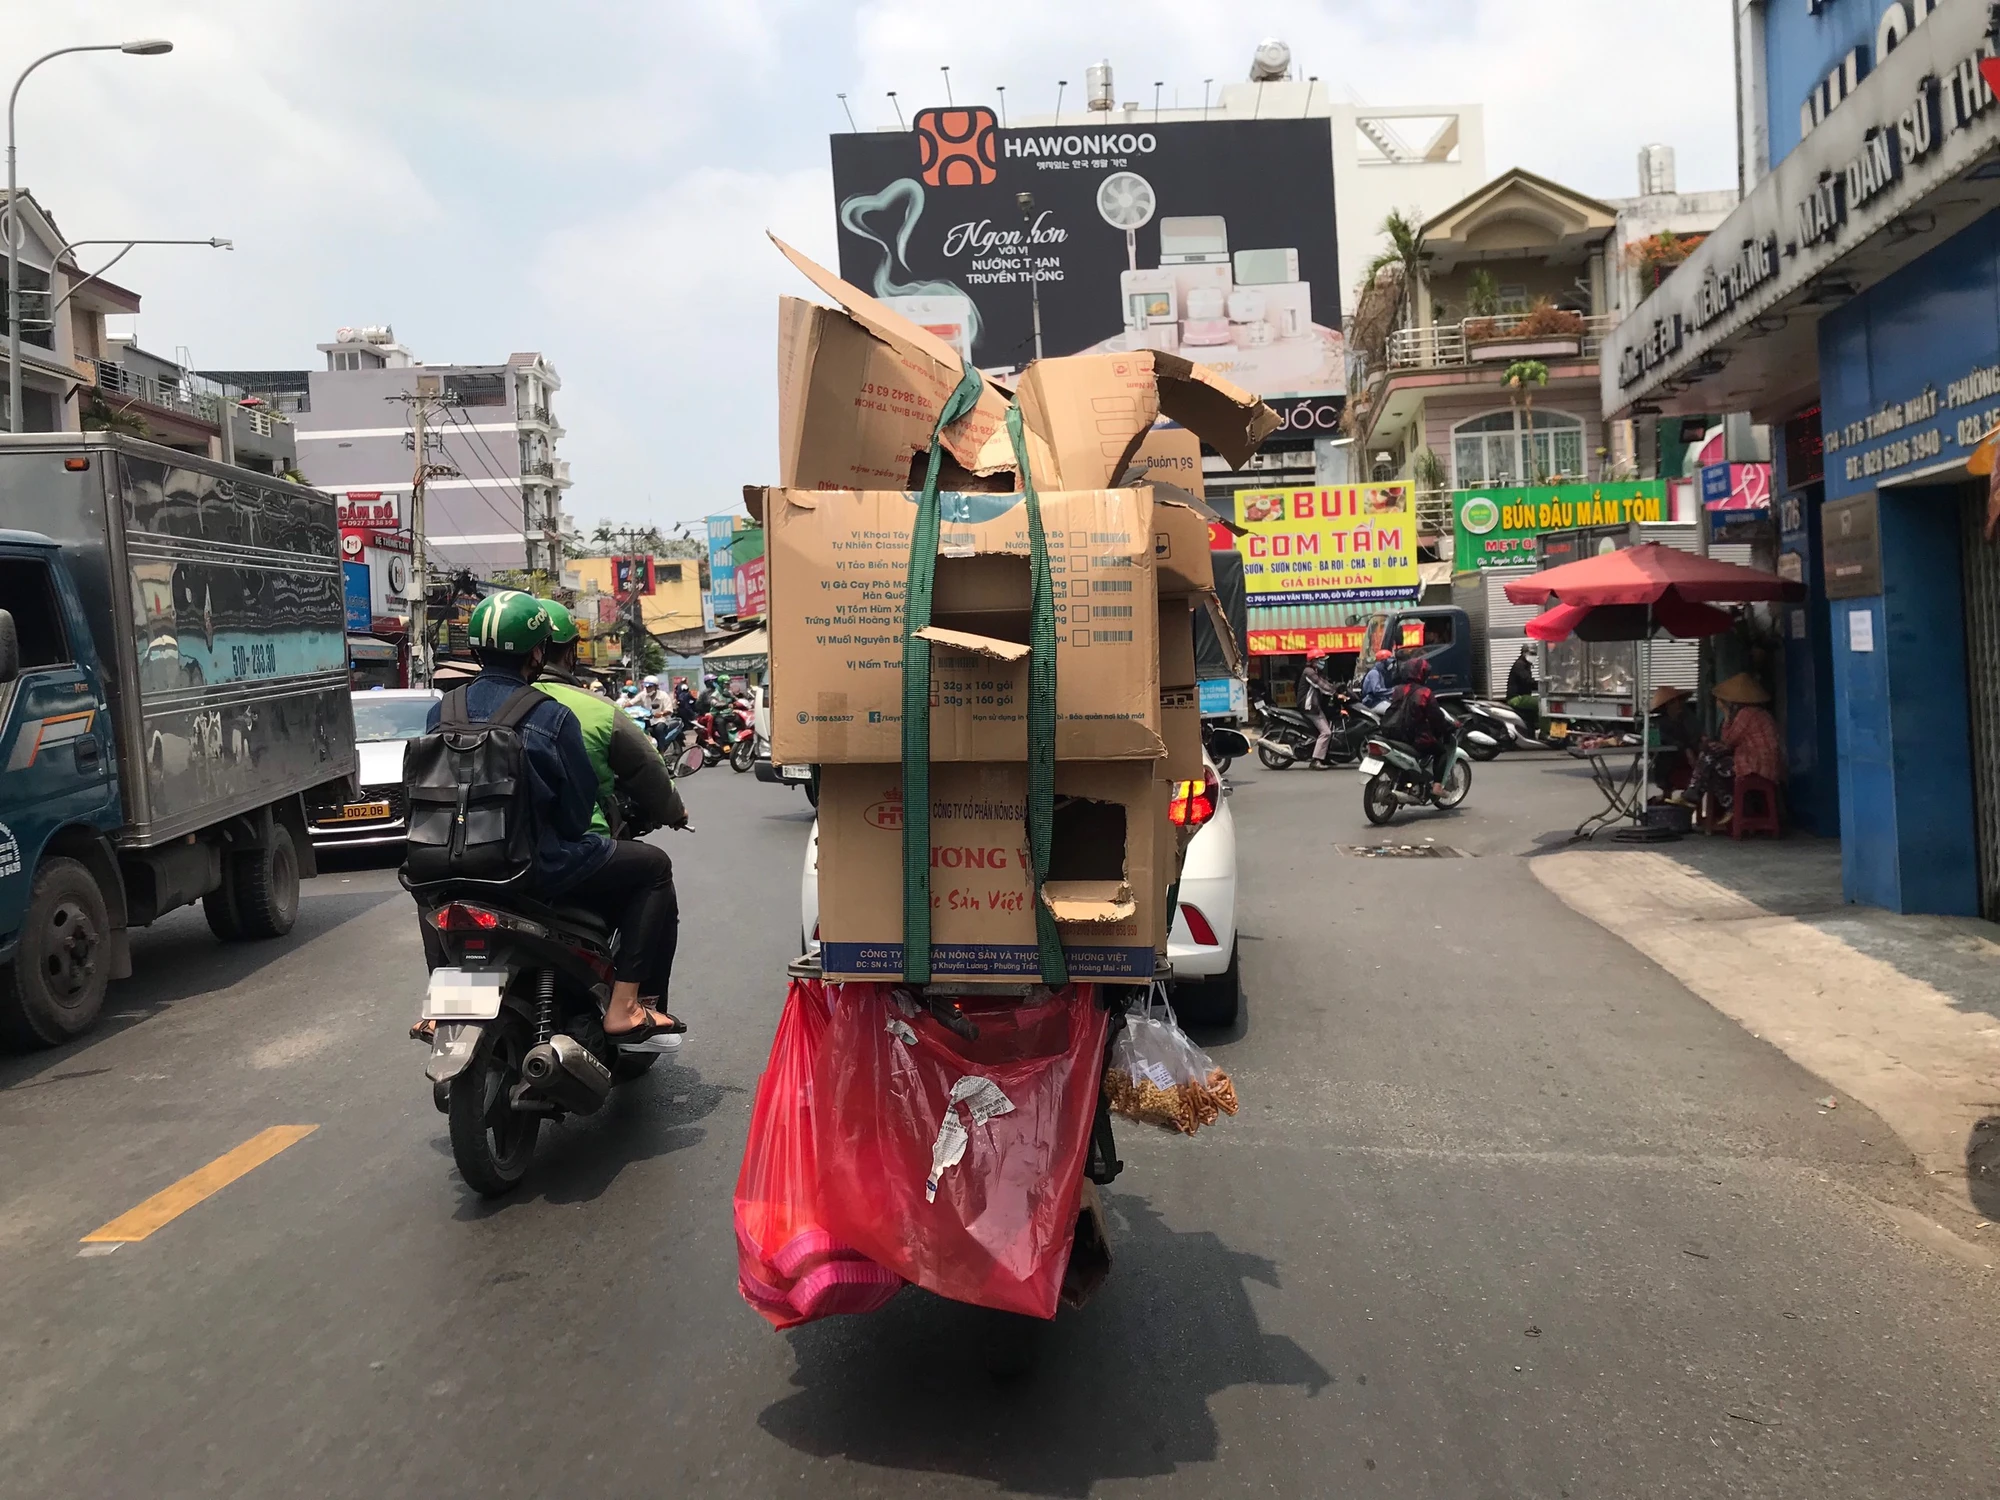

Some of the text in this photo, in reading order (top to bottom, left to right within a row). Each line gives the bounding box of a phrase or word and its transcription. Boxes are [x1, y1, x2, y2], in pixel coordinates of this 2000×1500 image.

[1004, 133, 1156, 157] HAWONKOO
[943, 210, 1068, 257] Ngon hơn
[972, 257, 1021, 270] NƯỚNG
[966, 268, 1065, 284] TRUYỀN THỐNG
[861, 382, 874, 393] 67
[877, 386, 888, 397] 63
[892, 388, 914, 403] 3842
[855, 398, 887, 412] TP.HCM
[1178, 456, 1193, 471] Số
[1502, 489, 1660, 531] BÚN ĐẬU MẮM TÔM
[851, 531, 860, 540] Vị
[893, 531, 910, 540] Tây
[1015, 531, 1024, 540] Vị
[1250, 519, 1400, 558] CƠM TẤM
[832, 541, 910, 551] Tự Nhiên Classic
[1485, 539, 1520, 552] MẸT
[836, 561, 845, 571] Vị
[868, 559, 888, 569] Biển
[1320, 560, 1329, 571] BA
[821, 580, 890, 591] Vị Gà Cay Phô
[1281, 573, 1372, 588] GIÁ BÌNH DÂN
[863, 591, 882, 600] Hàn
[1267, 594, 1286, 602] PHAN
[1287, 593, 1300, 601] VĂN
[836, 604, 892, 615] Vị Tôm Hùm
[527, 606, 548, 631] Grab
[805, 614, 890, 626] Trứng Muối Hoàng
[816, 634, 890, 646] Vị Muối Nguyên
[1249, 630, 1343, 651] CƠM TẤM BÚN
[847, 658, 881, 670] Vị Nấm
[943, 680, 1014, 693] 32g x 160 gói
[943, 695, 963, 707] 30g
[975, 695, 994, 705] 160
[997, 695, 1014, 708] gói
[973, 714, 988, 722] Hạn
[999, 714, 1016, 723] dụng
[1085, 713, 1103, 722] quản
[1117, 712, 1130, 720] khô
[1131, 712, 1145, 720] mát
[933, 799, 952, 819] CÔNG
[953, 803, 962, 818] TY
[993, 800, 1014, 820] NÔNG
[930, 846, 1007, 869] ƯƠNG
[949, 888, 980, 911] Sản
[988, 889, 1023, 915] Việt
[860, 948, 887, 959] CÔNG
[948, 949, 975, 959] NÔNG
[978, 949, 997, 960] SẢN
[1000, 950, 1012, 960] VÀ
[1014, 952, 1040, 962] THỰC
[1071, 952, 1105, 962] HƯƠNG
[1107, 953, 1128, 962] VIỆT
[938, 961, 965, 970] Khuyến
[967, 962, 988, 970] Lương
[994, 962, 1021, 970] Phường
[1022, 962, 1038, 970] Trần
[1079, 963, 1101, 972] Hoàng
